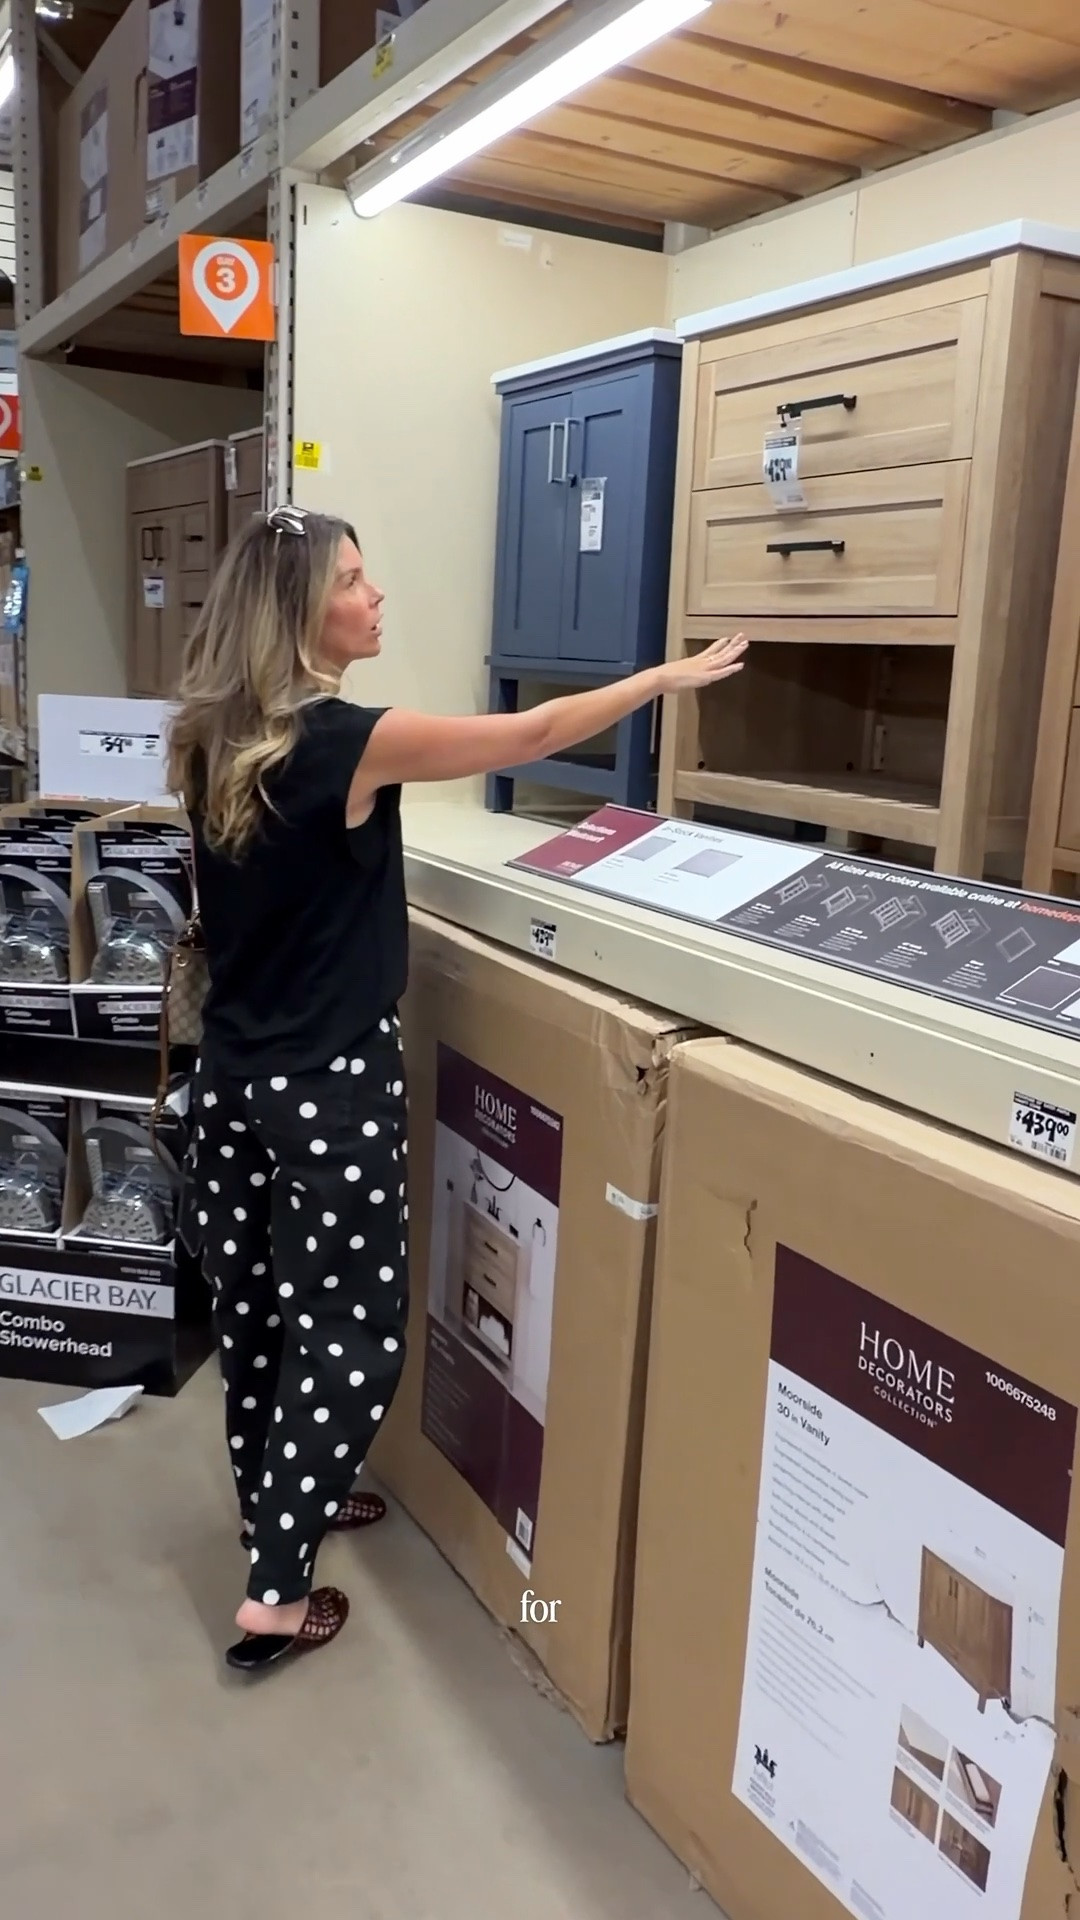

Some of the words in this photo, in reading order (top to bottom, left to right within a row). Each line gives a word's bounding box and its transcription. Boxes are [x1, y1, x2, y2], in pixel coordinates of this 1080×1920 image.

[215, 268, 236, 293] 3
[865, 871, 890, 880] and
[967, 892, 1005, 906] online
[1018, 901, 1080, 923] homedep
[475, 1084, 517, 1131] HOME
[0, 1272, 101, 1304] GLACIER
[108, 1285, 157, 1311] BAY
[0, 1311, 66, 1333] Combo
[0, 1329, 113, 1358] Showerhead
[860, 1321, 955, 1404] HOME
[778, 1382, 824, 1420] Moorside
[857, 1355, 953, 1423] DECORATORS
[985, 1370, 1057, 1421] 1006675248
[777, 1402, 791, 1418] 30
[800, 1416, 830, 1446] Vanity
